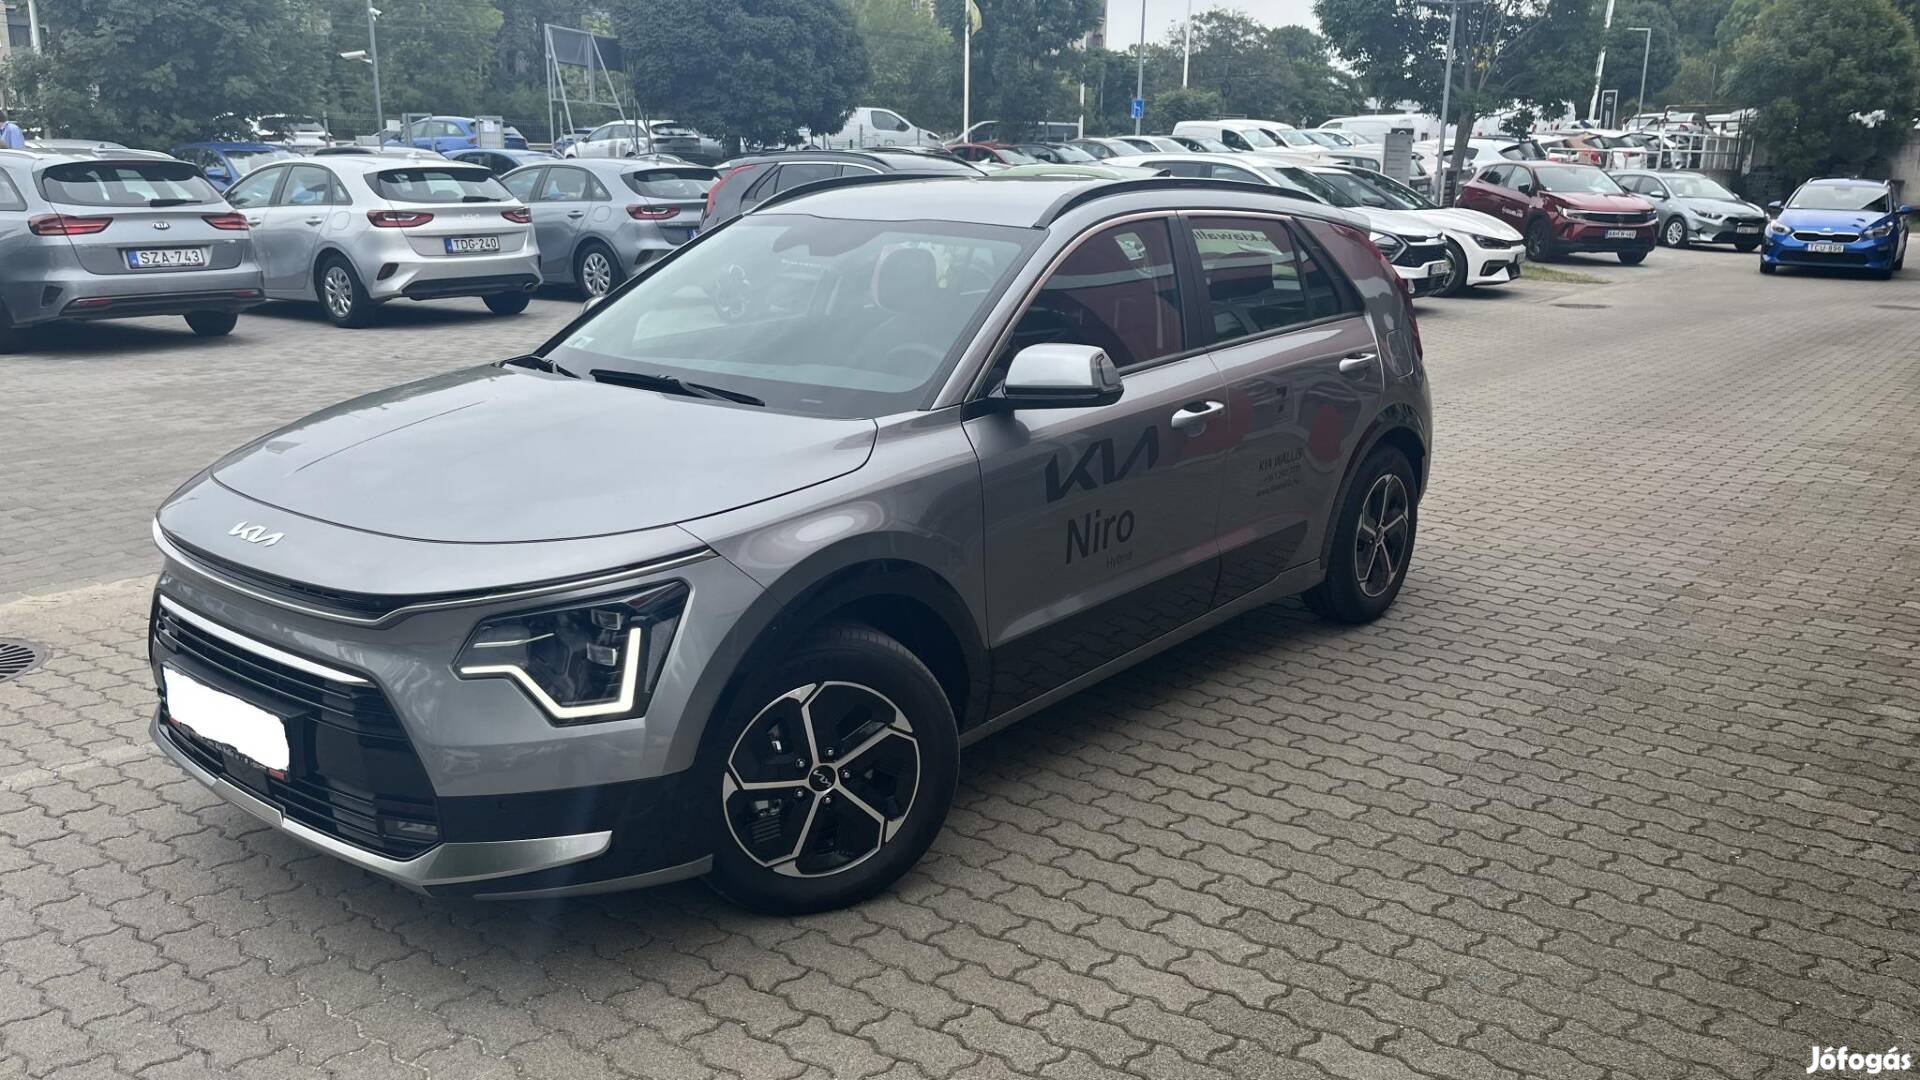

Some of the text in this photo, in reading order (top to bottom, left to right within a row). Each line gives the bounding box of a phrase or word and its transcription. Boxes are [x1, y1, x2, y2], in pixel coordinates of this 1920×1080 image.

[454, 238, 497, 250] TDG-240
[140, 251, 201, 265] SZA-743
[1045, 424, 1160, 503] KIA
[228, 520, 285, 547] KIA
[1066, 508, 1136, 566] Niro
